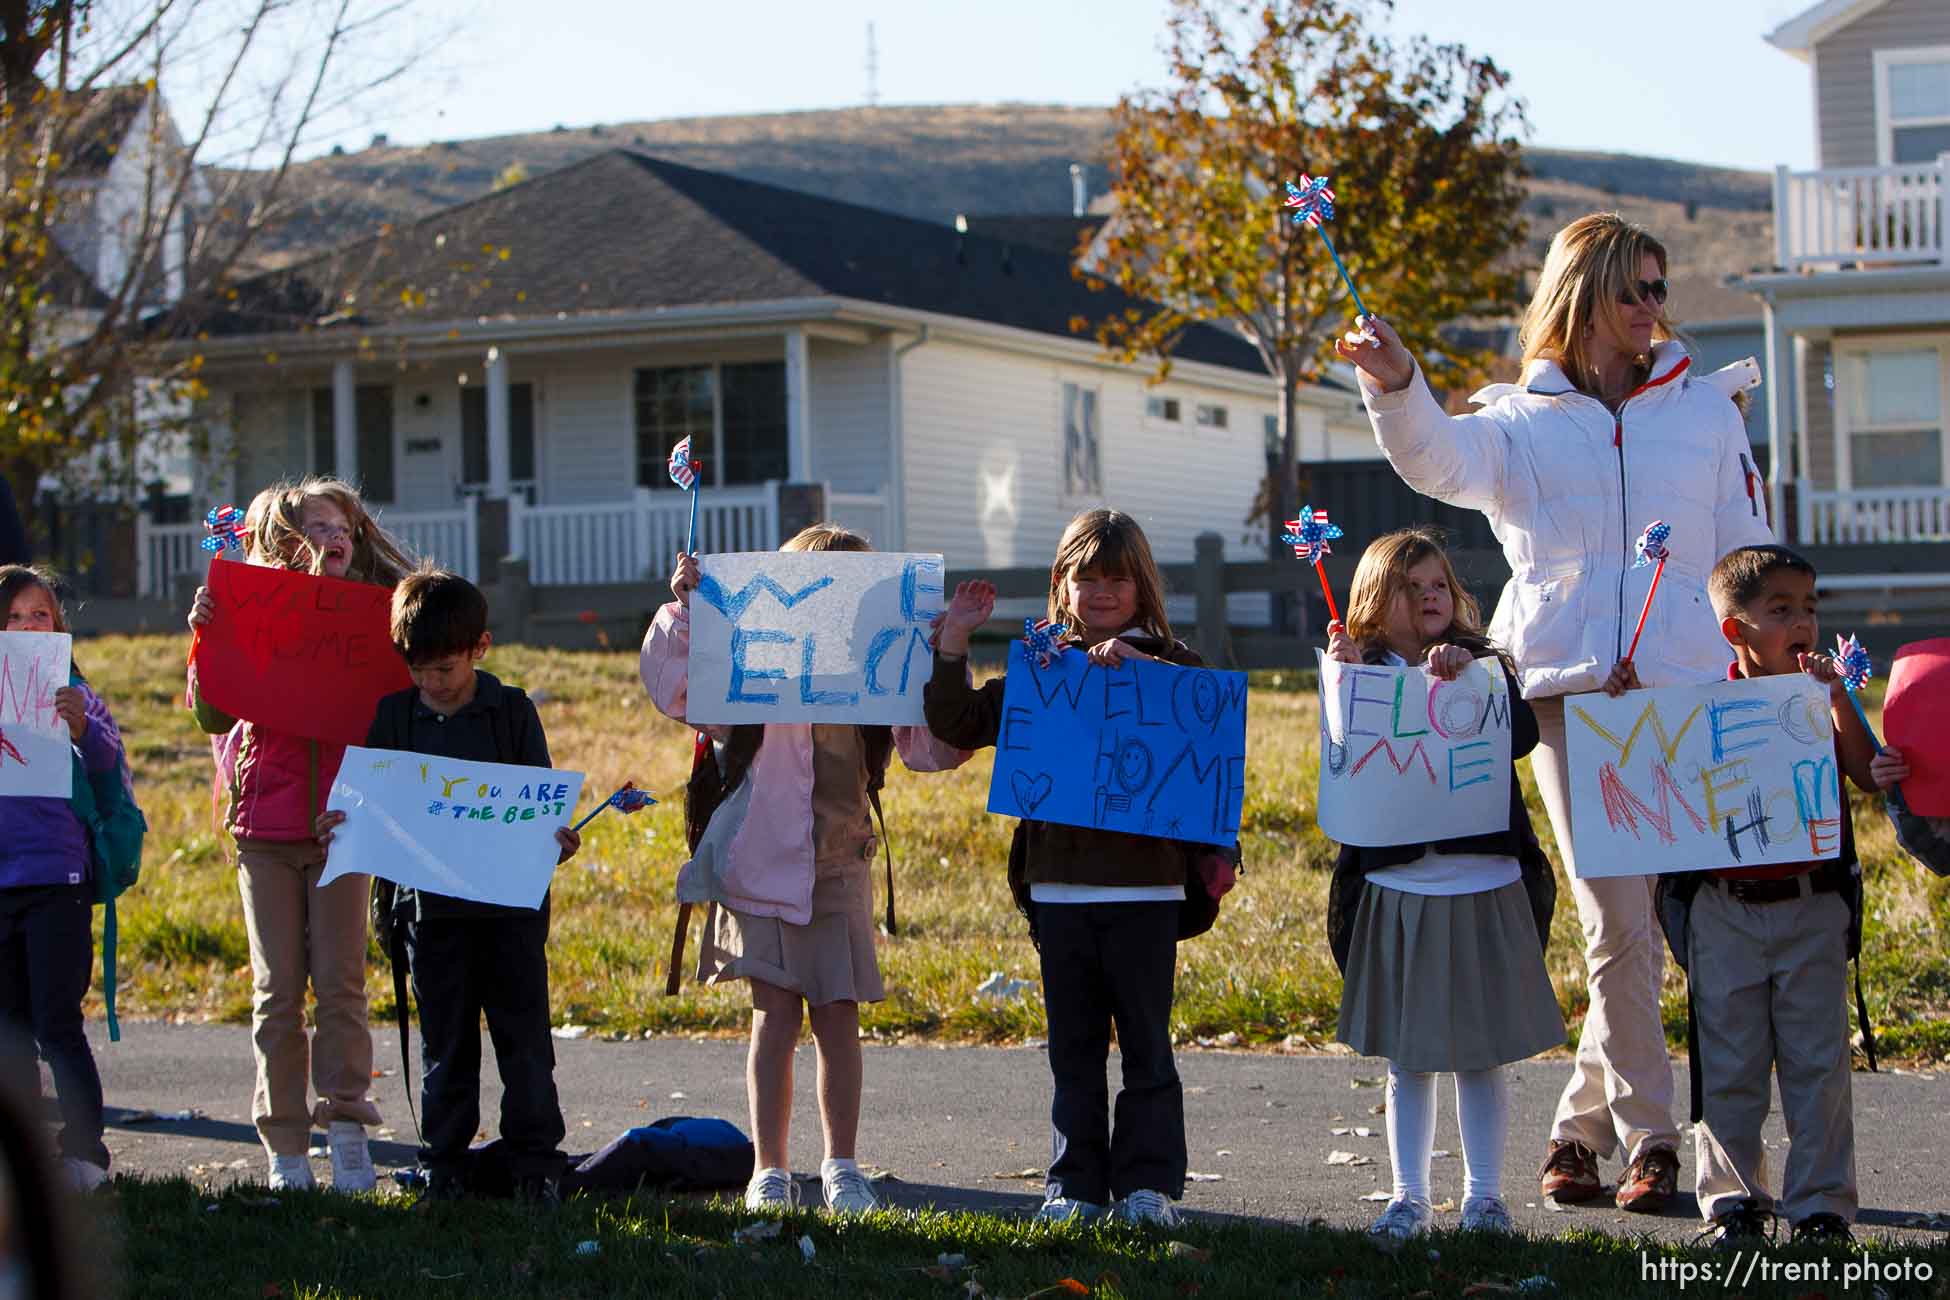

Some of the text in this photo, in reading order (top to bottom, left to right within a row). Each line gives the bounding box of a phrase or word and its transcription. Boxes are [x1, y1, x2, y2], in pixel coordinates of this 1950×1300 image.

[1030, 661, 1248, 738] WELCOM
[518, 782, 569, 801] ARE
[1094, 727, 1245, 836] HOME
[503, 801, 566, 824] BEST
